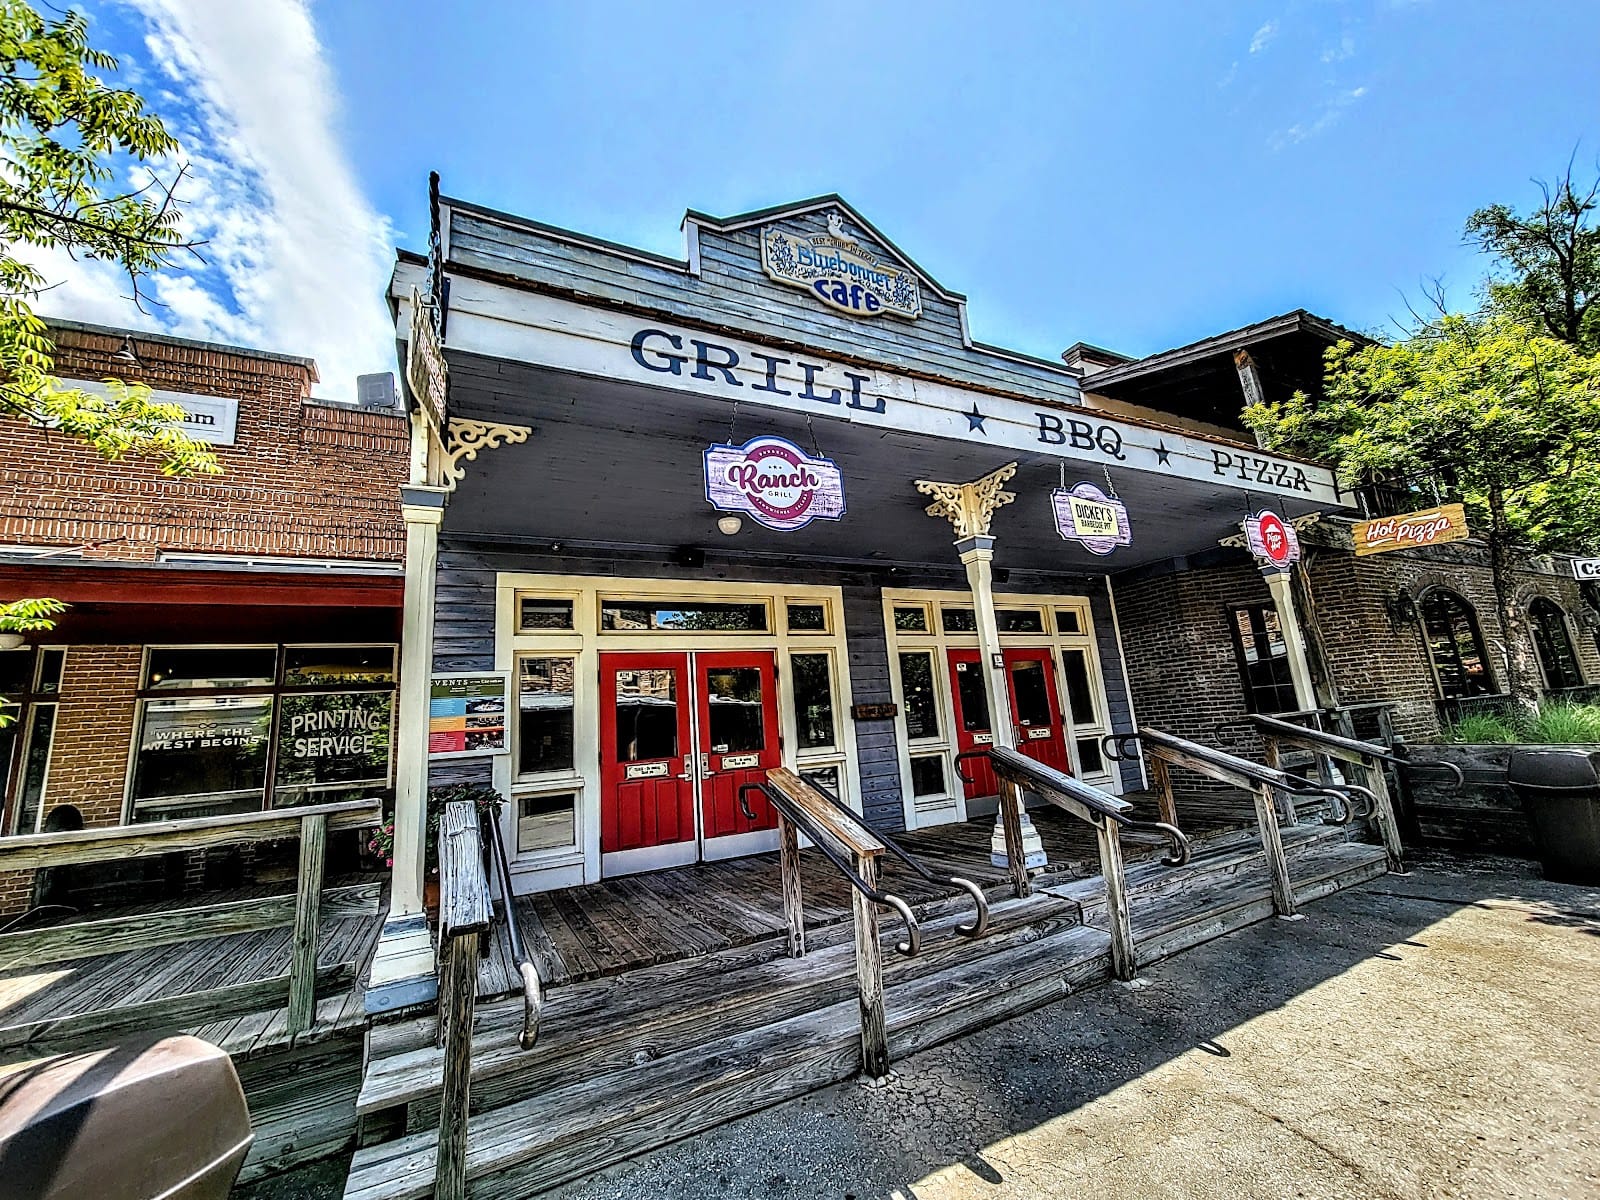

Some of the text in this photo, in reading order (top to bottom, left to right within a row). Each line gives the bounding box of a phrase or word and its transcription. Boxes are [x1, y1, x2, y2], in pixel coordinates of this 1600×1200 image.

[812, 237, 826, 246] BEST
[797, 244, 891, 291] Bluebonnet
[813, 279, 881, 312] cafe
[630, 328, 1311, 492] GRILL BBQ PIZZA
[728, 464, 819, 494] Ranch
[768, 490, 793, 499] GRILL
[1075, 503, 1113, 522] DICKEY'S
[1081, 519, 1104, 529] BARBECUE
[1366, 517, 1451, 543] Hot Pizza
[1266, 532, 1282, 544] Pizza
[1271, 540, 1282, 551] Hut
[222, 727, 253, 737] THE
[291, 709, 380, 736] PRINTING
[148, 740, 195, 751] WEST
[294, 735, 375, 758] SERVICE
